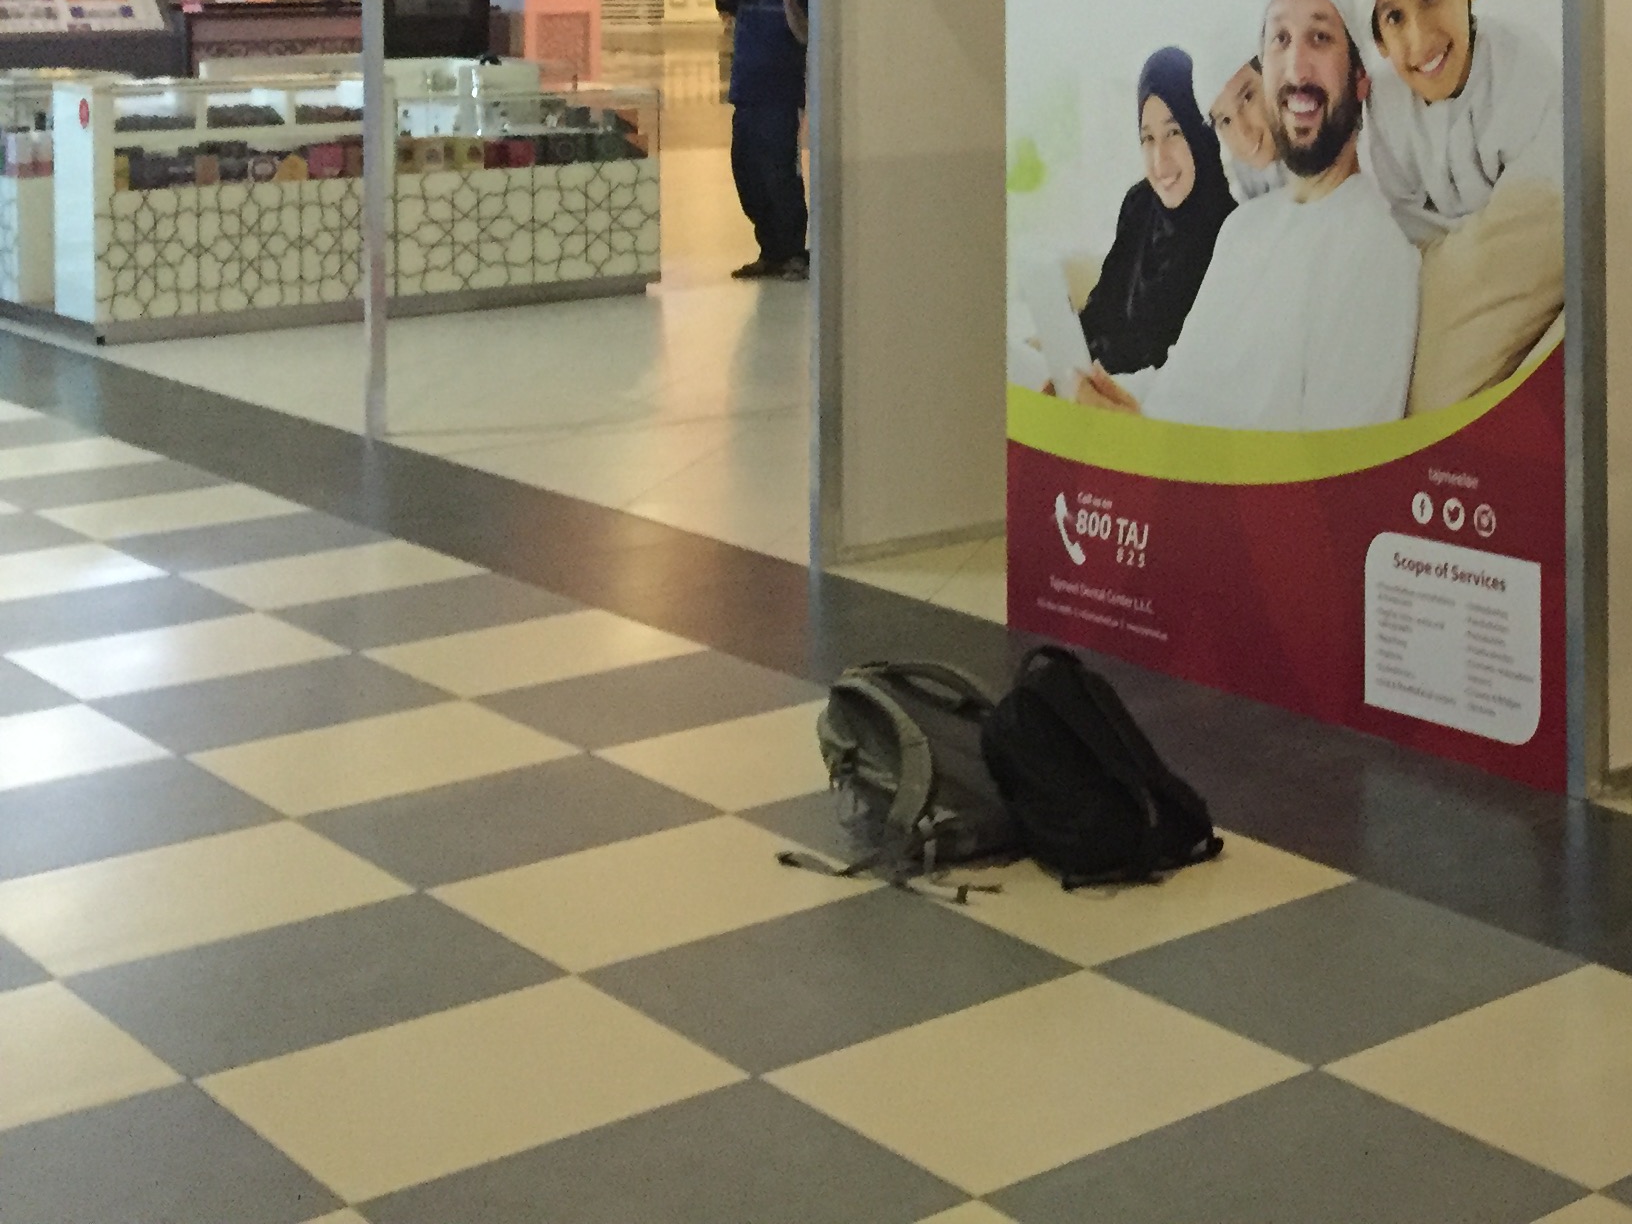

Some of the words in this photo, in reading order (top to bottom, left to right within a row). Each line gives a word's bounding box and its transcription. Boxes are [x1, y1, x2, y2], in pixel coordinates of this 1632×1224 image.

[1076, 508, 1112, 540] 800
[1116, 517, 1149, 550] TAJ
[1392, 552, 1433, 577] Scope
[1434, 560, 1449, 579] of
[1451, 564, 1507, 593] Services
